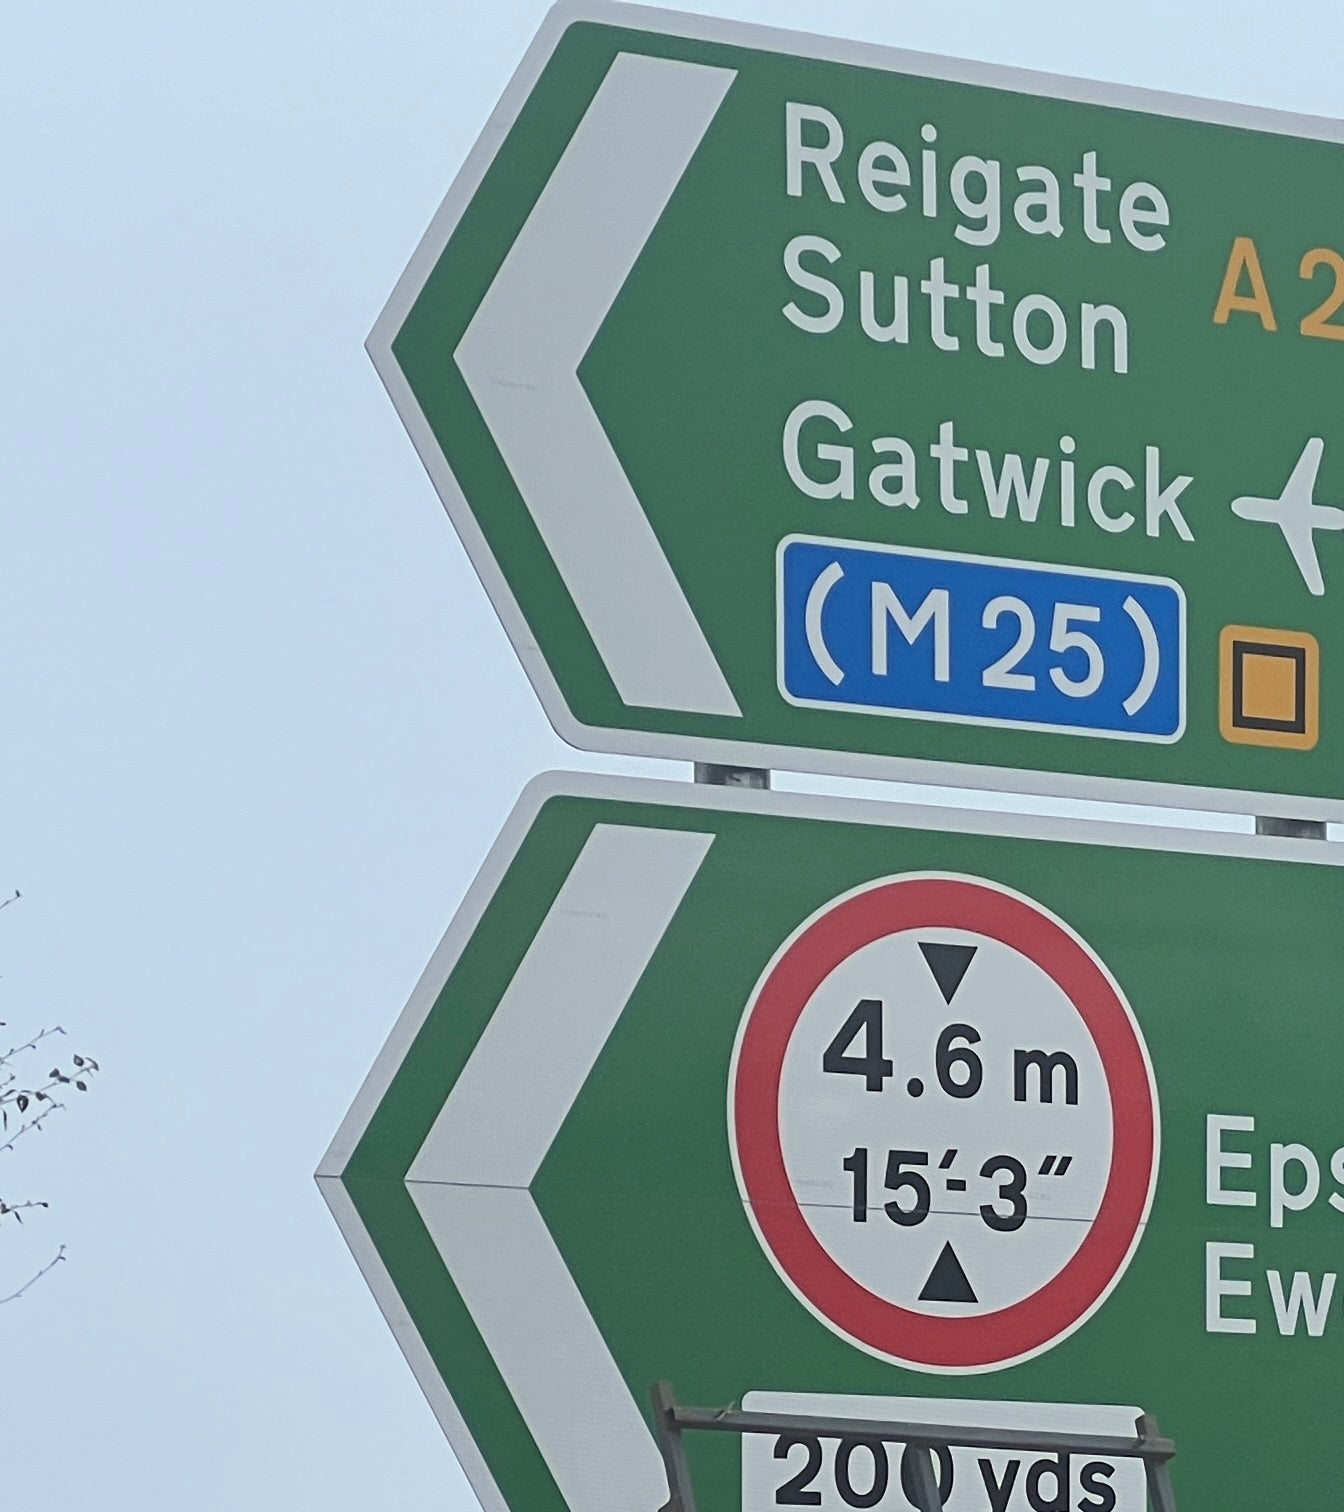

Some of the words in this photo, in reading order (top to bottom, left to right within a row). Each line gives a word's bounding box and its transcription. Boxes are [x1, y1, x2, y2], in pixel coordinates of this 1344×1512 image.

[786, 101, 1170, 252] Reigate
[782, 235, 1128, 374] Sutton
[783, 400, 1194, 541] Gatwick
[823, 999, 982, 1098] 4.6
[1013, 1048, 1079, 1105] m
[773, 1434, 954, 1511] 200
